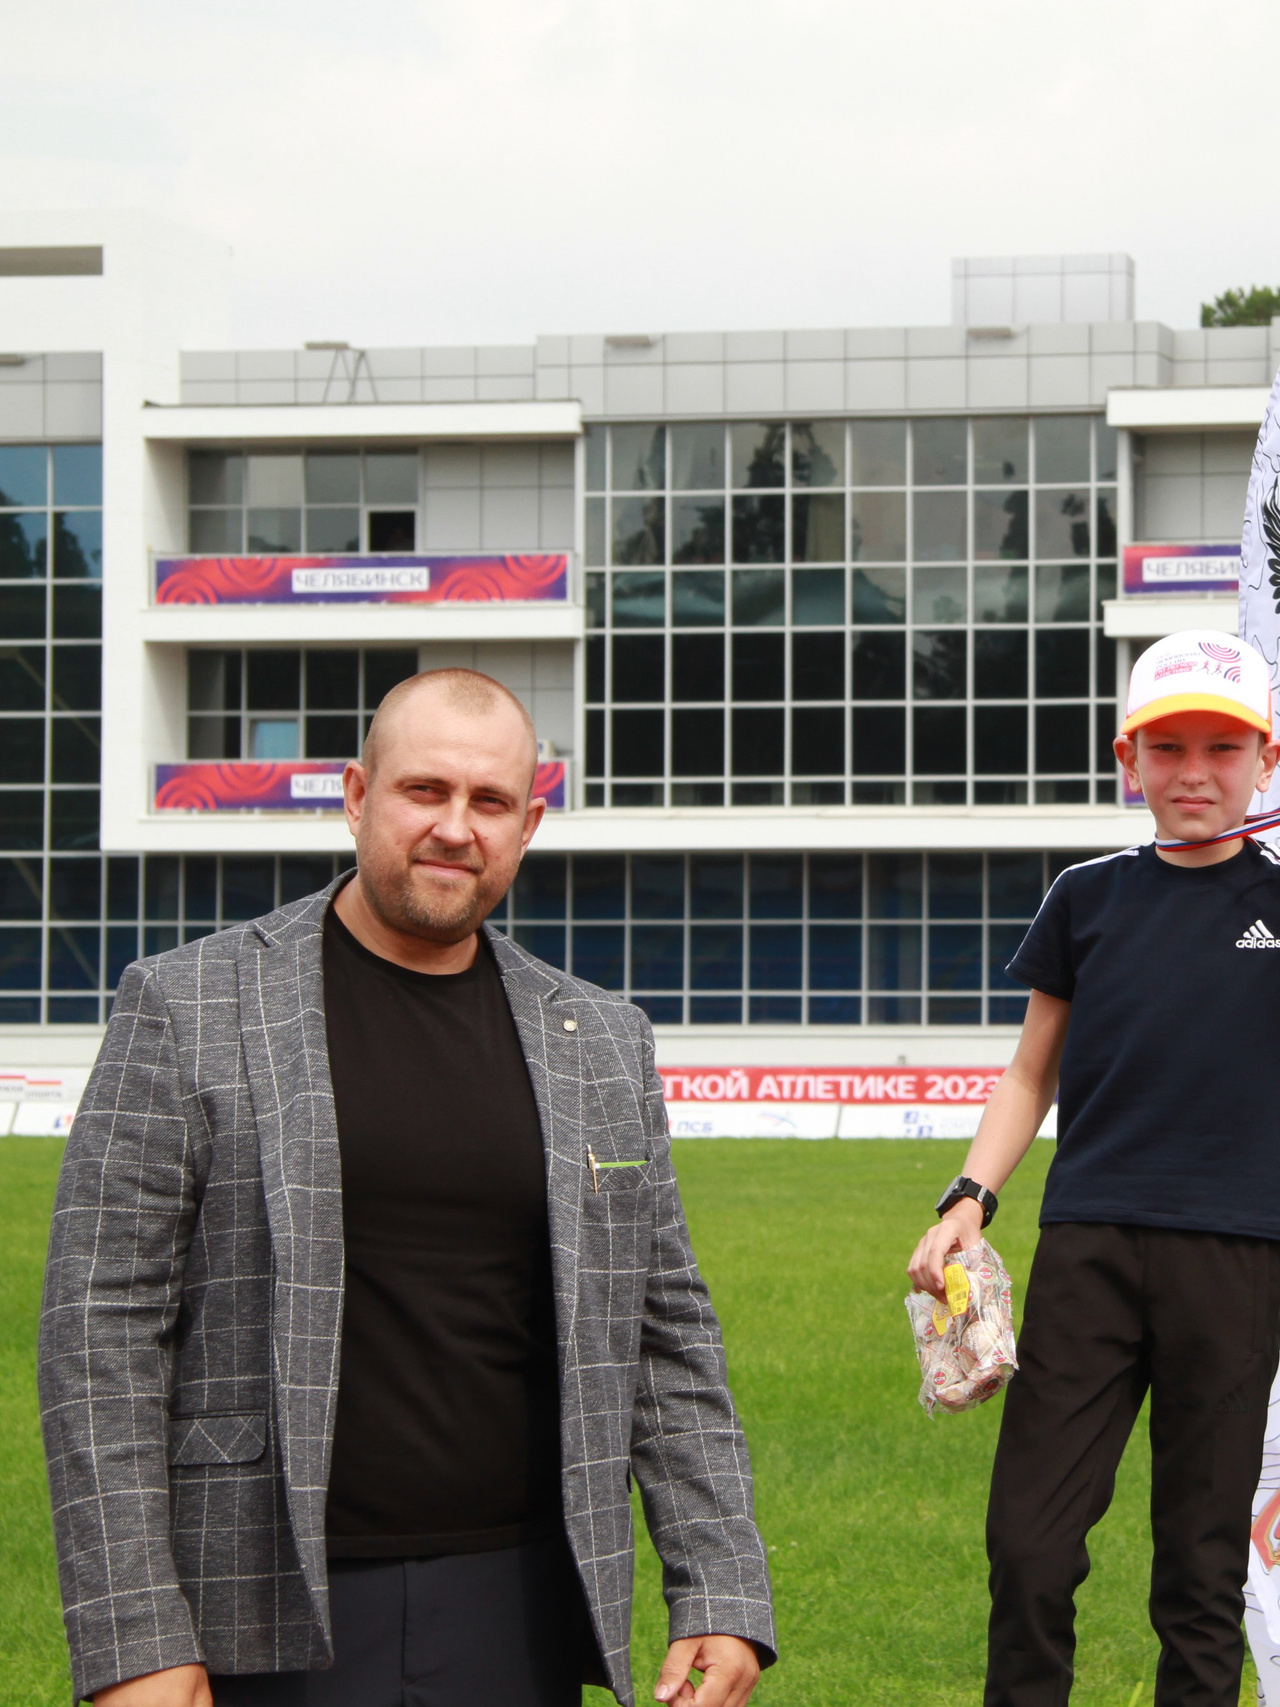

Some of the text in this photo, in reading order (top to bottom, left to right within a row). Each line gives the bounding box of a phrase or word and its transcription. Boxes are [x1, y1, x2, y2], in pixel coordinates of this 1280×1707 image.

[296, 572, 423, 587] ЧЕЛЯБИНСК
[662, 1069, 751, 1100] ГКОЙ
[756, 1074, 918, 1101] АТЛЕТИКЕ
